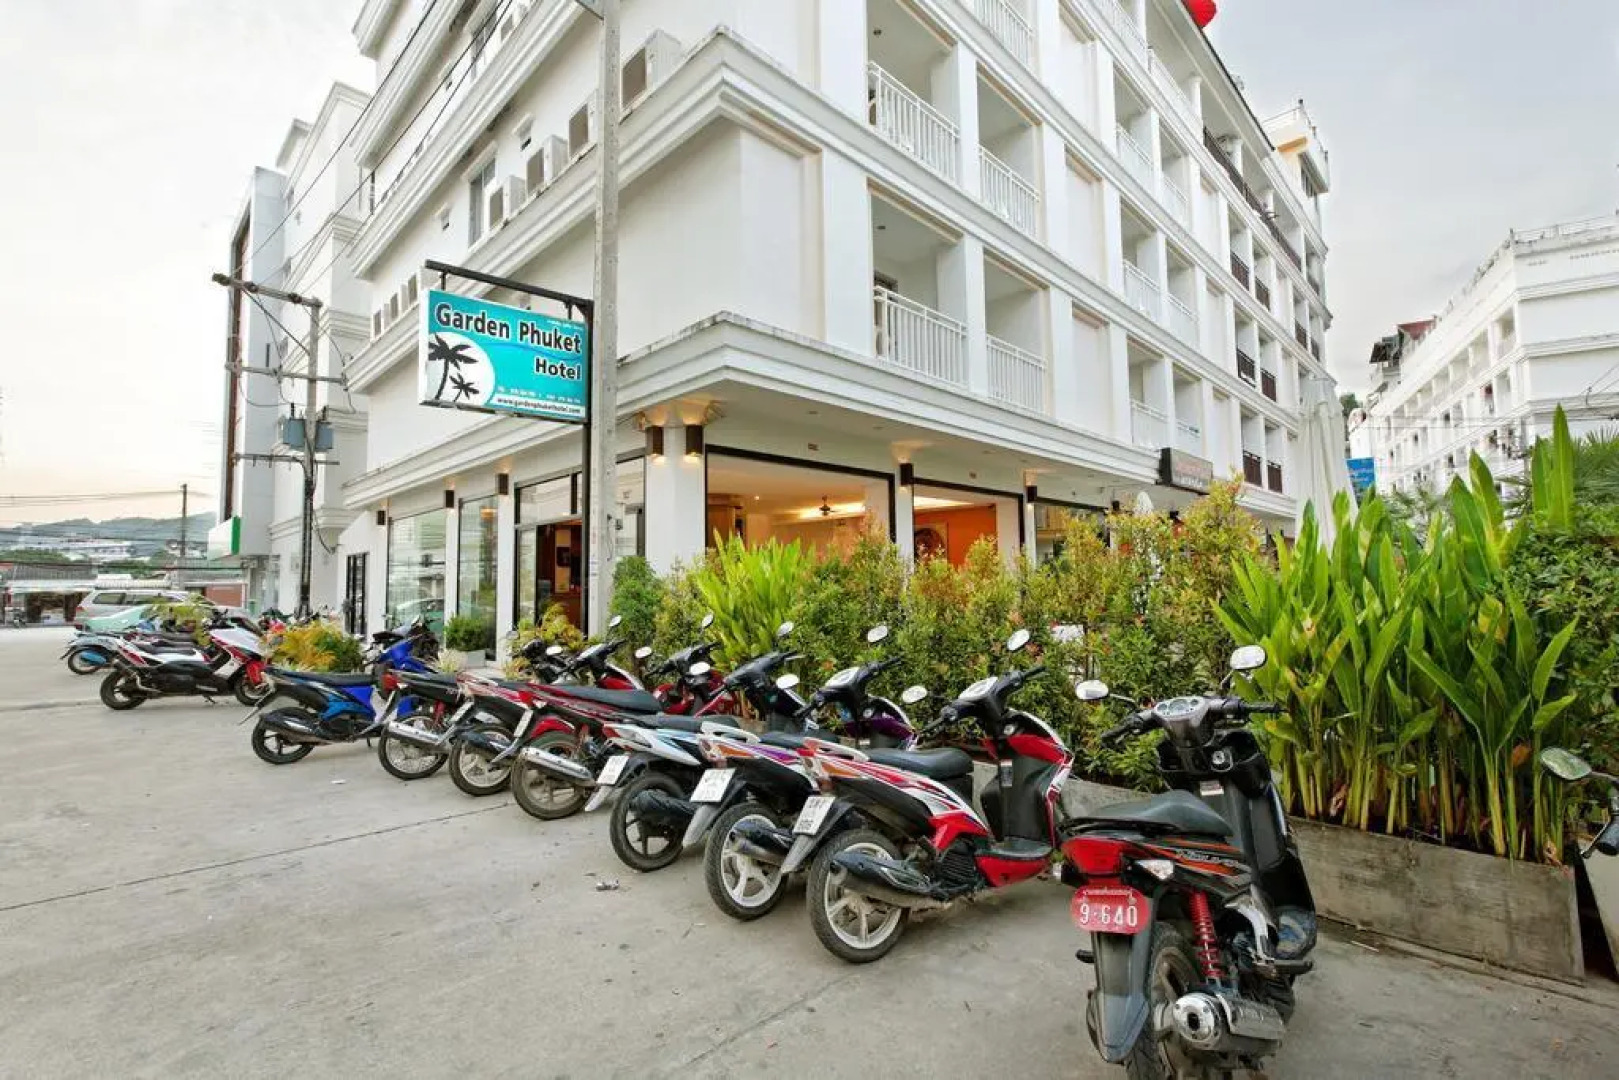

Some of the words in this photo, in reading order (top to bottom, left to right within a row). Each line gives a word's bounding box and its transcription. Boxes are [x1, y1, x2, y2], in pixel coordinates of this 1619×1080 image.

[436, 304, 510, 339] Garden
[519, 322, 581, 354] Phuket
[535, 357, 581, 380] Hotel
